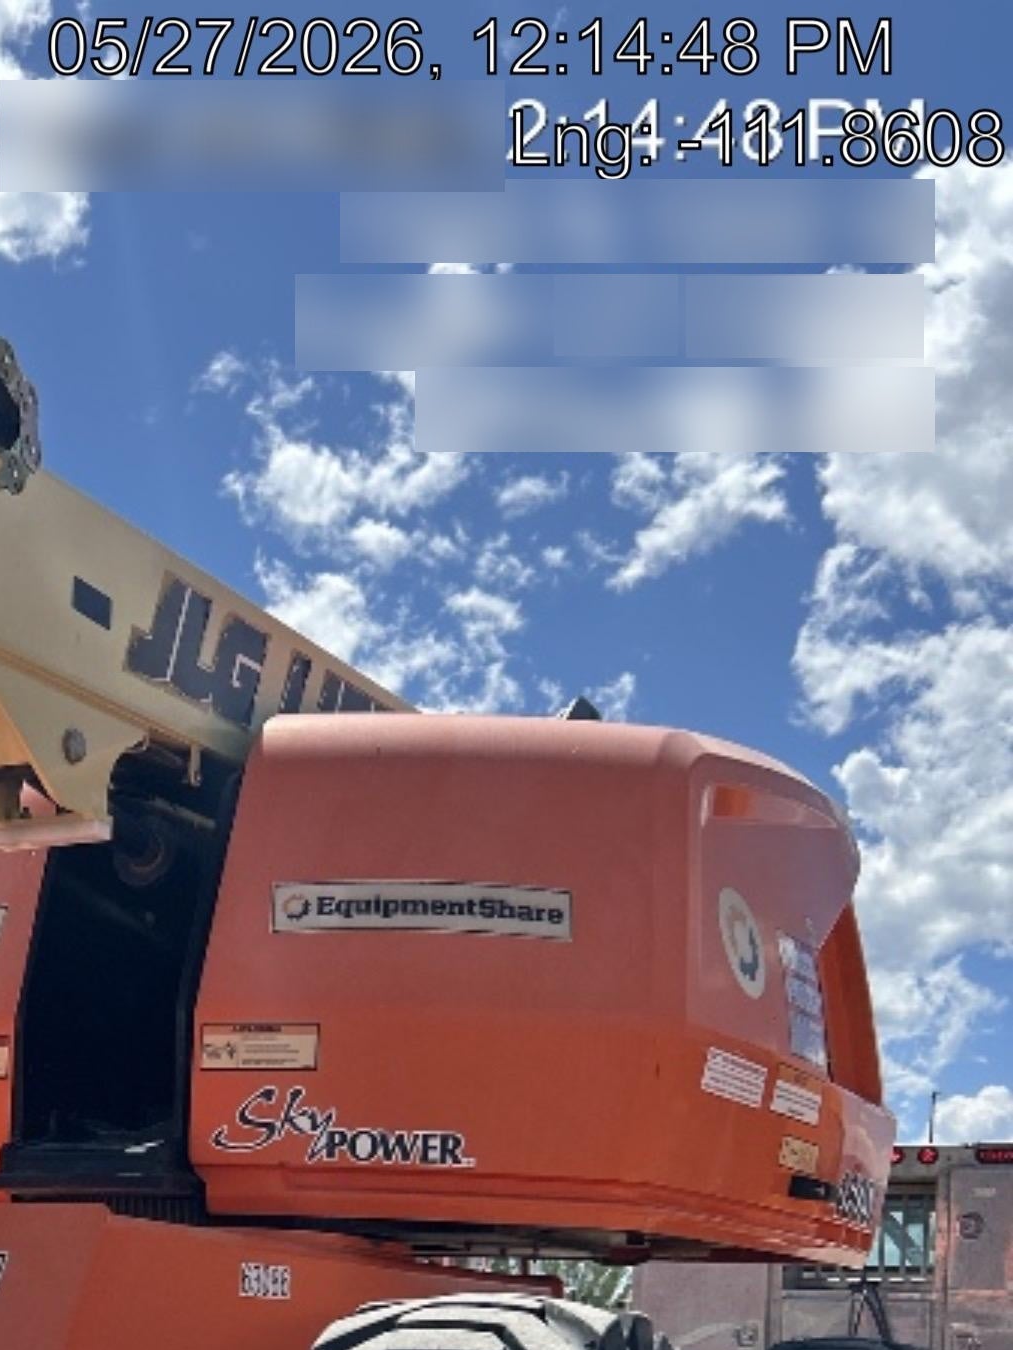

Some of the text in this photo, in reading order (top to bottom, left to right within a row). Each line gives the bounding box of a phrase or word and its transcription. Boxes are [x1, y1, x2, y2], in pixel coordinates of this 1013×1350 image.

[123, 571, 270, 729] JLG
[316, 895, 564, 925] EquipmentShare
[212, 1086, 336, 1164] Sky
[324, 1129, 466, 1167] POWER
